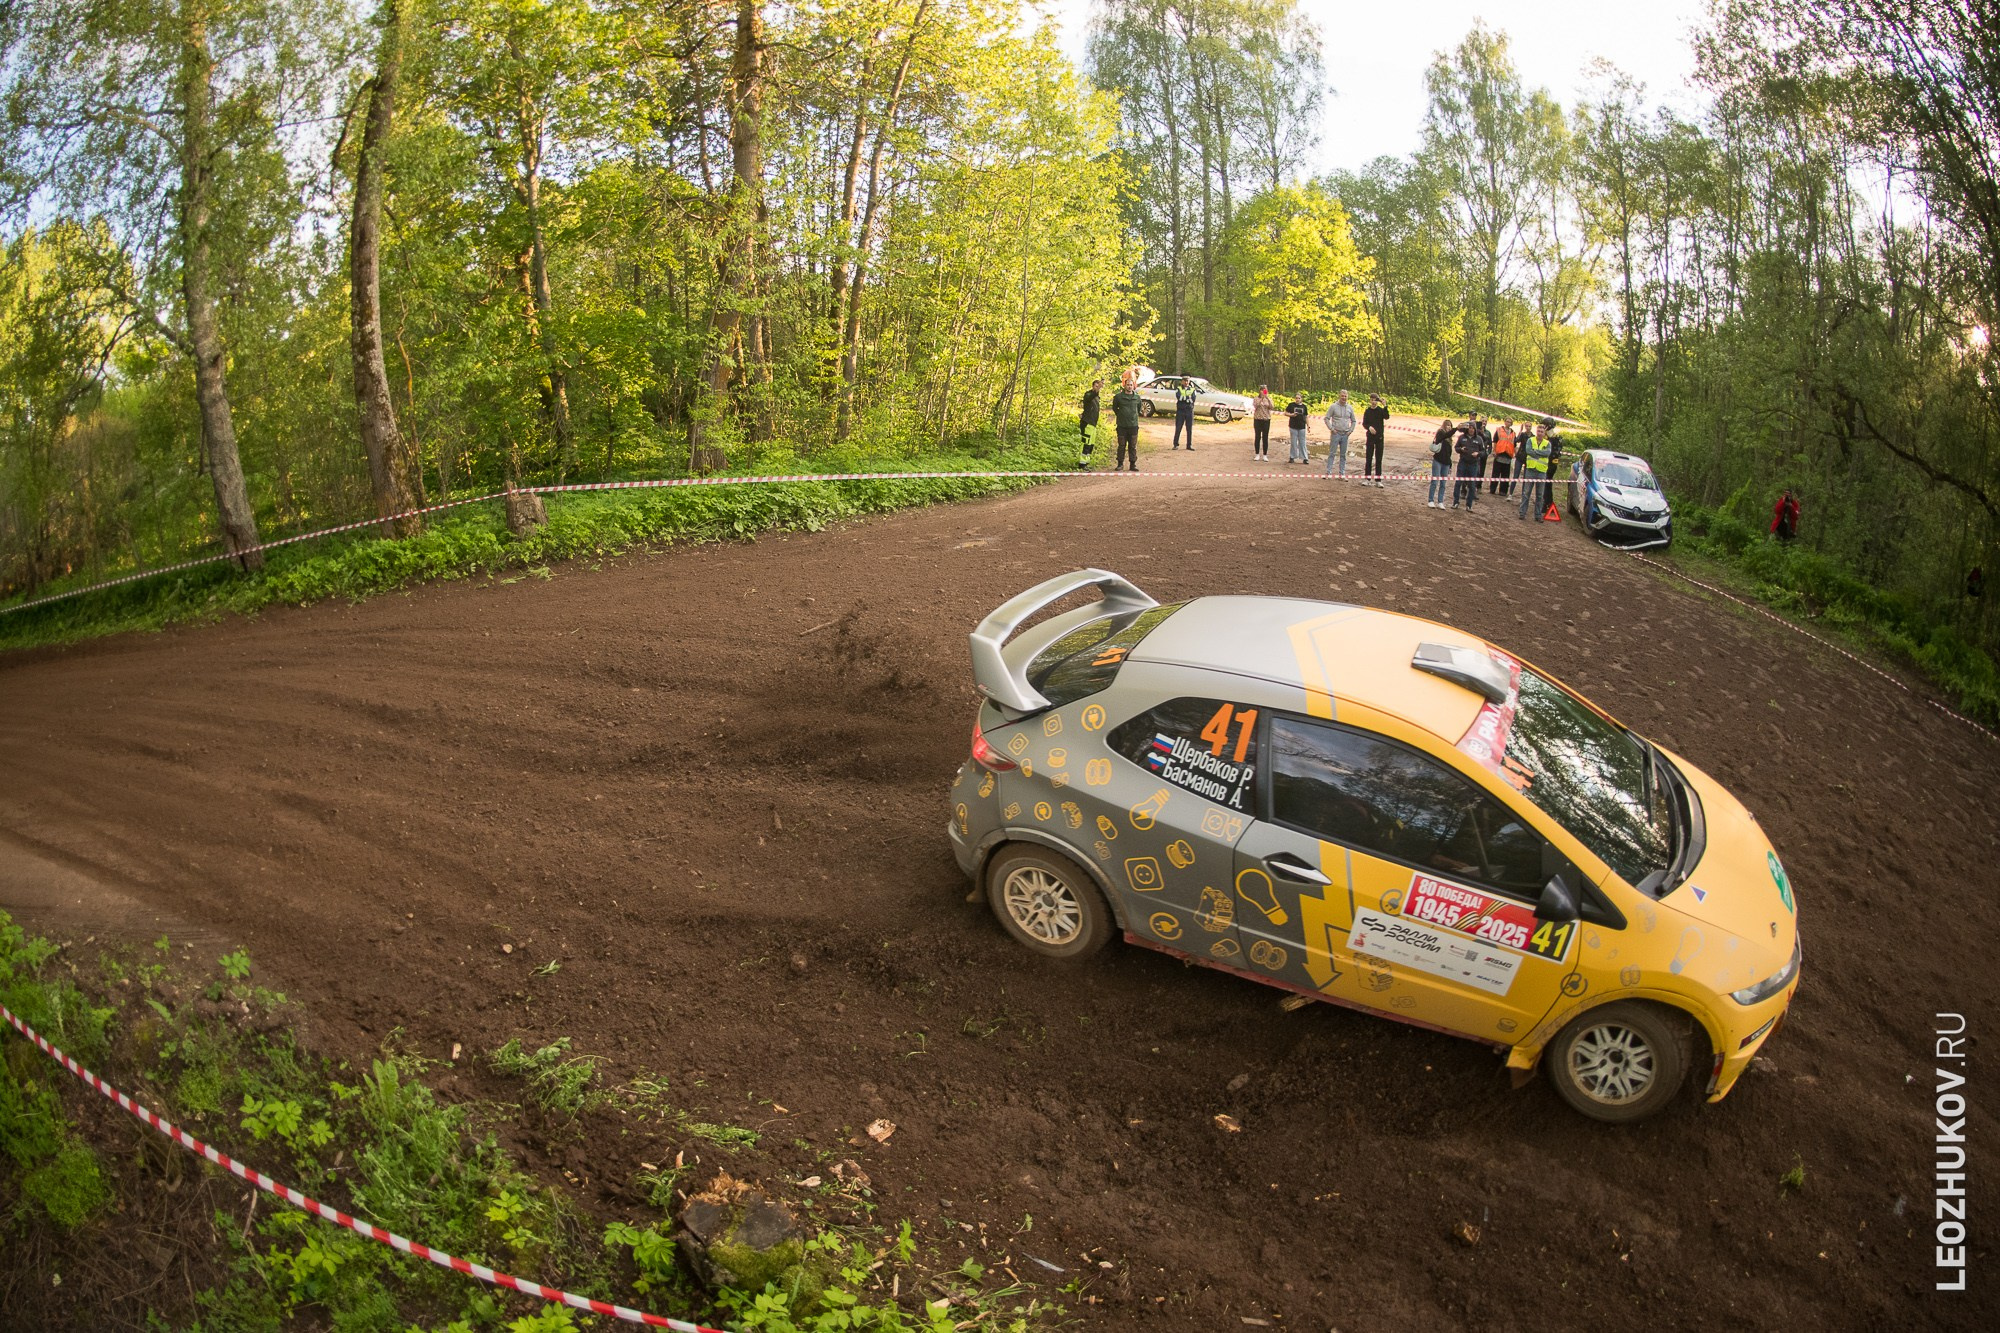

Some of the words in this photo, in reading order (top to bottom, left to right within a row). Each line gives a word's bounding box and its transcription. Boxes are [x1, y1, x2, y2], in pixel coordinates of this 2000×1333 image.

[1200, 703, 1258, 763] 41
[1163, 759, 1227, 800] Басманов
[1228, 788, 1244, 810] А.
[1171, 737, 1238, 783] Щербаков
[1238, 768, 1254, 791] Р.
[1418, 878, 1437, 896] 80
[1437, 885, 1483, 909] ПОБЕДА!
[1384, 931, 1442, 954] РОССИИ
[1390, 924, 1439, 943] РАЛЛИ
[1412, 895, 1462, 926] 1945
[1475, 915, 1530, 949] 2025
[1531, 920, 1571, 958] 41
